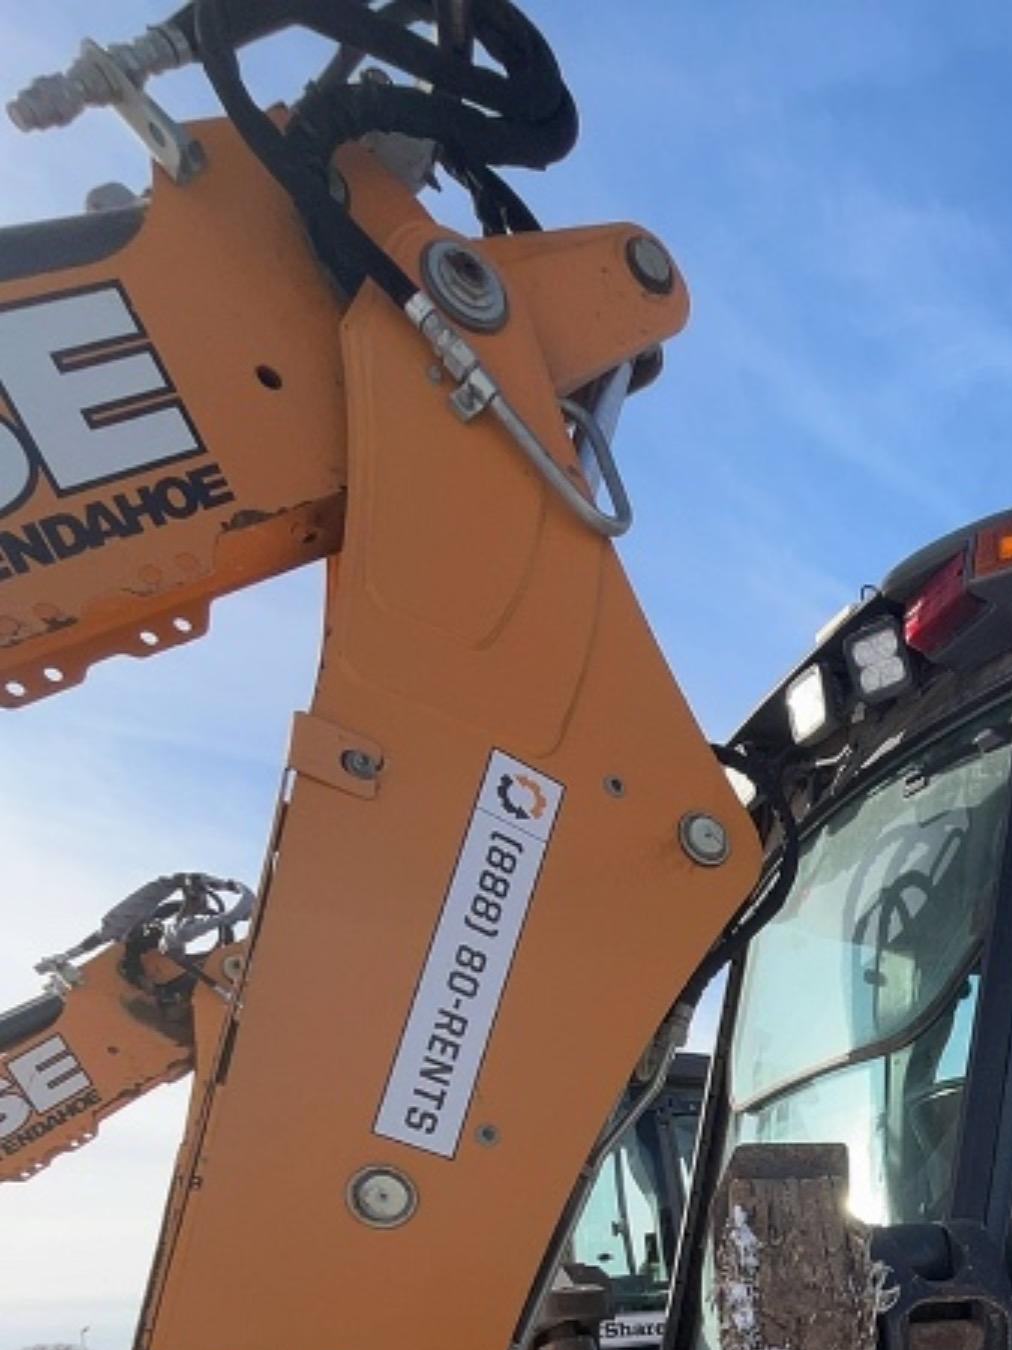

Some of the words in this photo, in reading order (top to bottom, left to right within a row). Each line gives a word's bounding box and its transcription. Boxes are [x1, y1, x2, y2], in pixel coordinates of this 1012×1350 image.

[0, 279, 207, 516] E
[464, 831, 524, 938] (888)
[405, 944, 487, 1135] 80-RENTS
